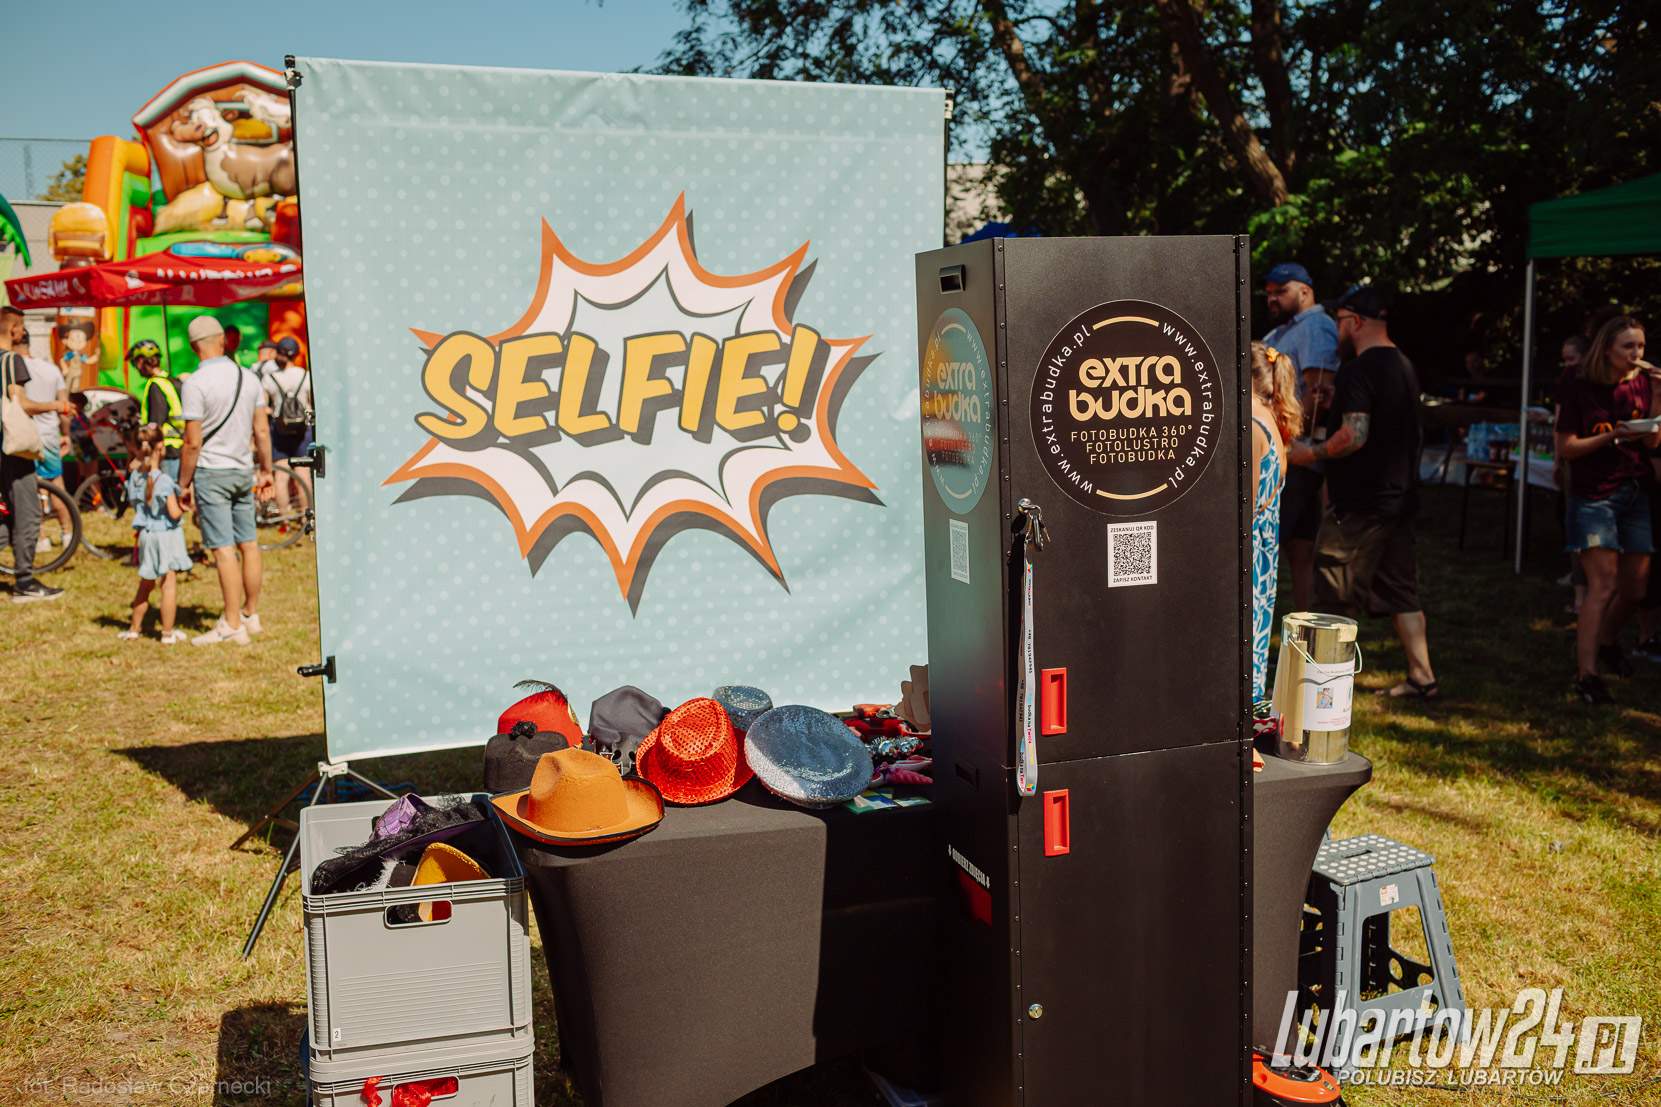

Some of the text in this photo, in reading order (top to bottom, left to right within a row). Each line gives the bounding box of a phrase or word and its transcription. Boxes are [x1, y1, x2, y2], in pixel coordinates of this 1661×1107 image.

[937, 361, 976, 390] extra
[1078, 355, 1181, 387] extra
[414, 323, 820, 453] SELFIE!
[1068, 387, 1191, 421] budka
[934, 390, 981, 423] budka
[1040, 325, 1092, 493] www.extrabudka.pl
[1161, 322, 1214, 489] www.extrabudka.pl
[1070, 424, 1193, 443] FOTOBUDKA 360°
[1085, 437, 1179, 453] FOTOLUSTRO
[1089, 449, 1176, 465] FOTOBUDKA
